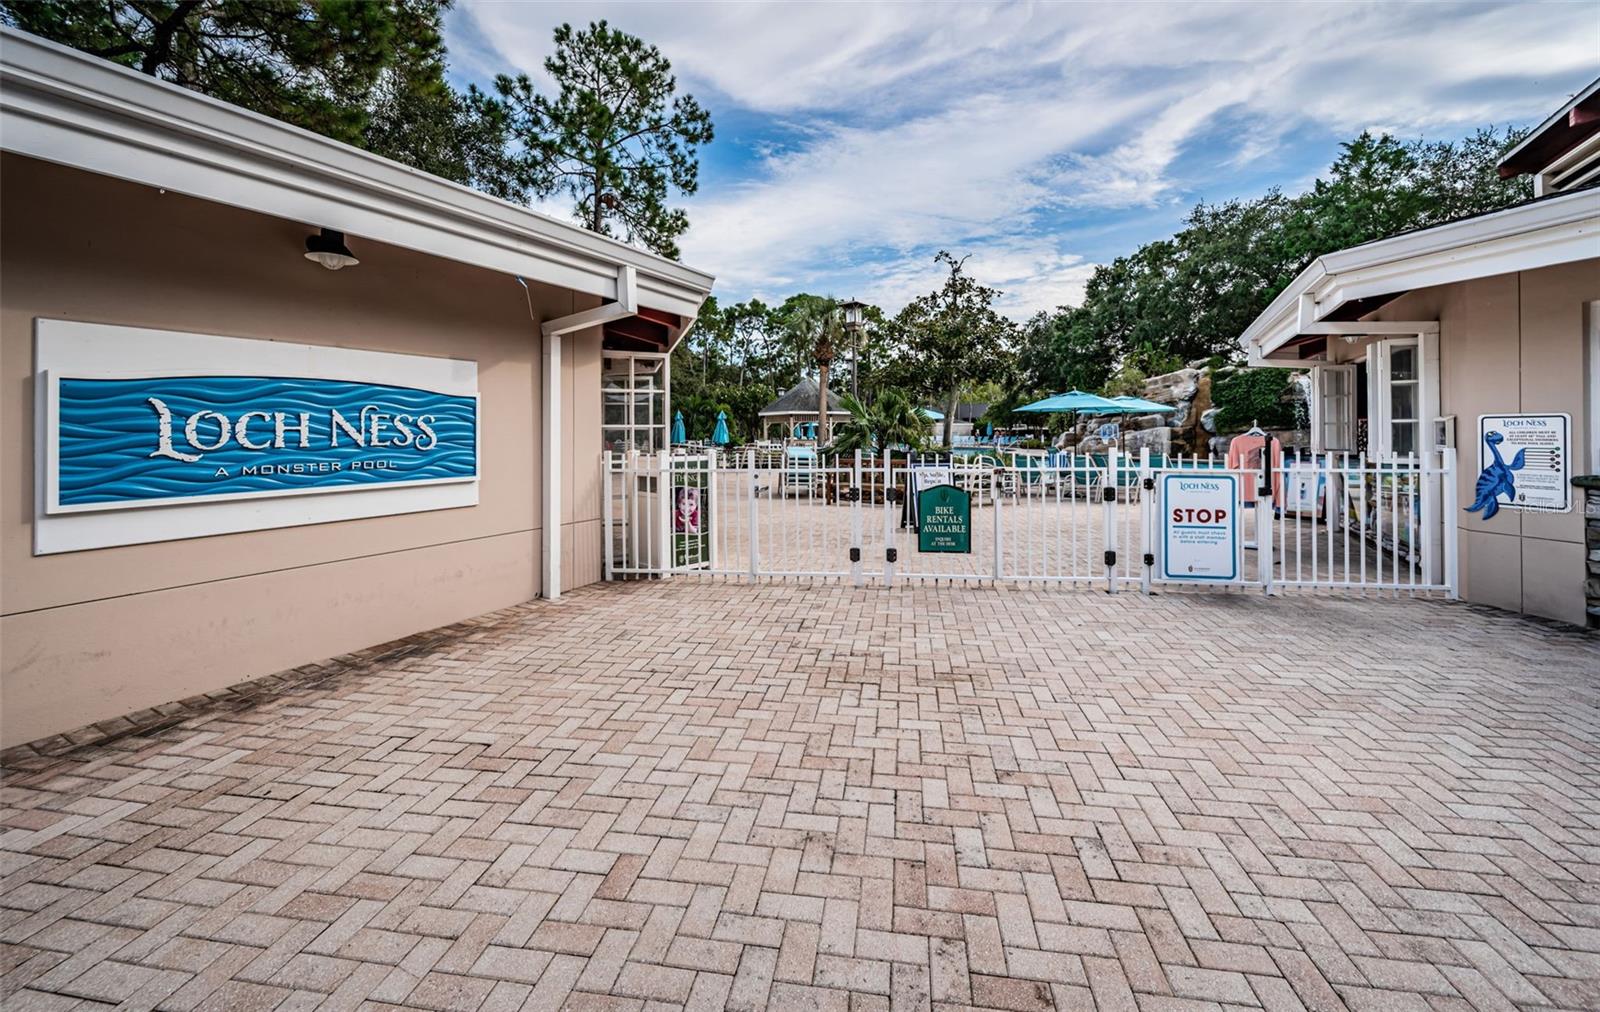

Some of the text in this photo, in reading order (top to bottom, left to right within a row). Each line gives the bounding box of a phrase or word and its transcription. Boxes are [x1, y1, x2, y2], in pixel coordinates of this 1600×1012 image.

[1503, 419, 1547, 428] LOCH NESS
[147, 397, 438, 463] LOCH NESS
[214, 460, 398, 477] A MONSTER POOL
[1180, 482, 1220, 491] LOCH NESS
[935, 506, 954, 515] BIKE
[926, 515, 963, 524] RENTALS
[1173, 508, 1227, 523] STOP
[923, 524, 967, 533] AVAILABLE
